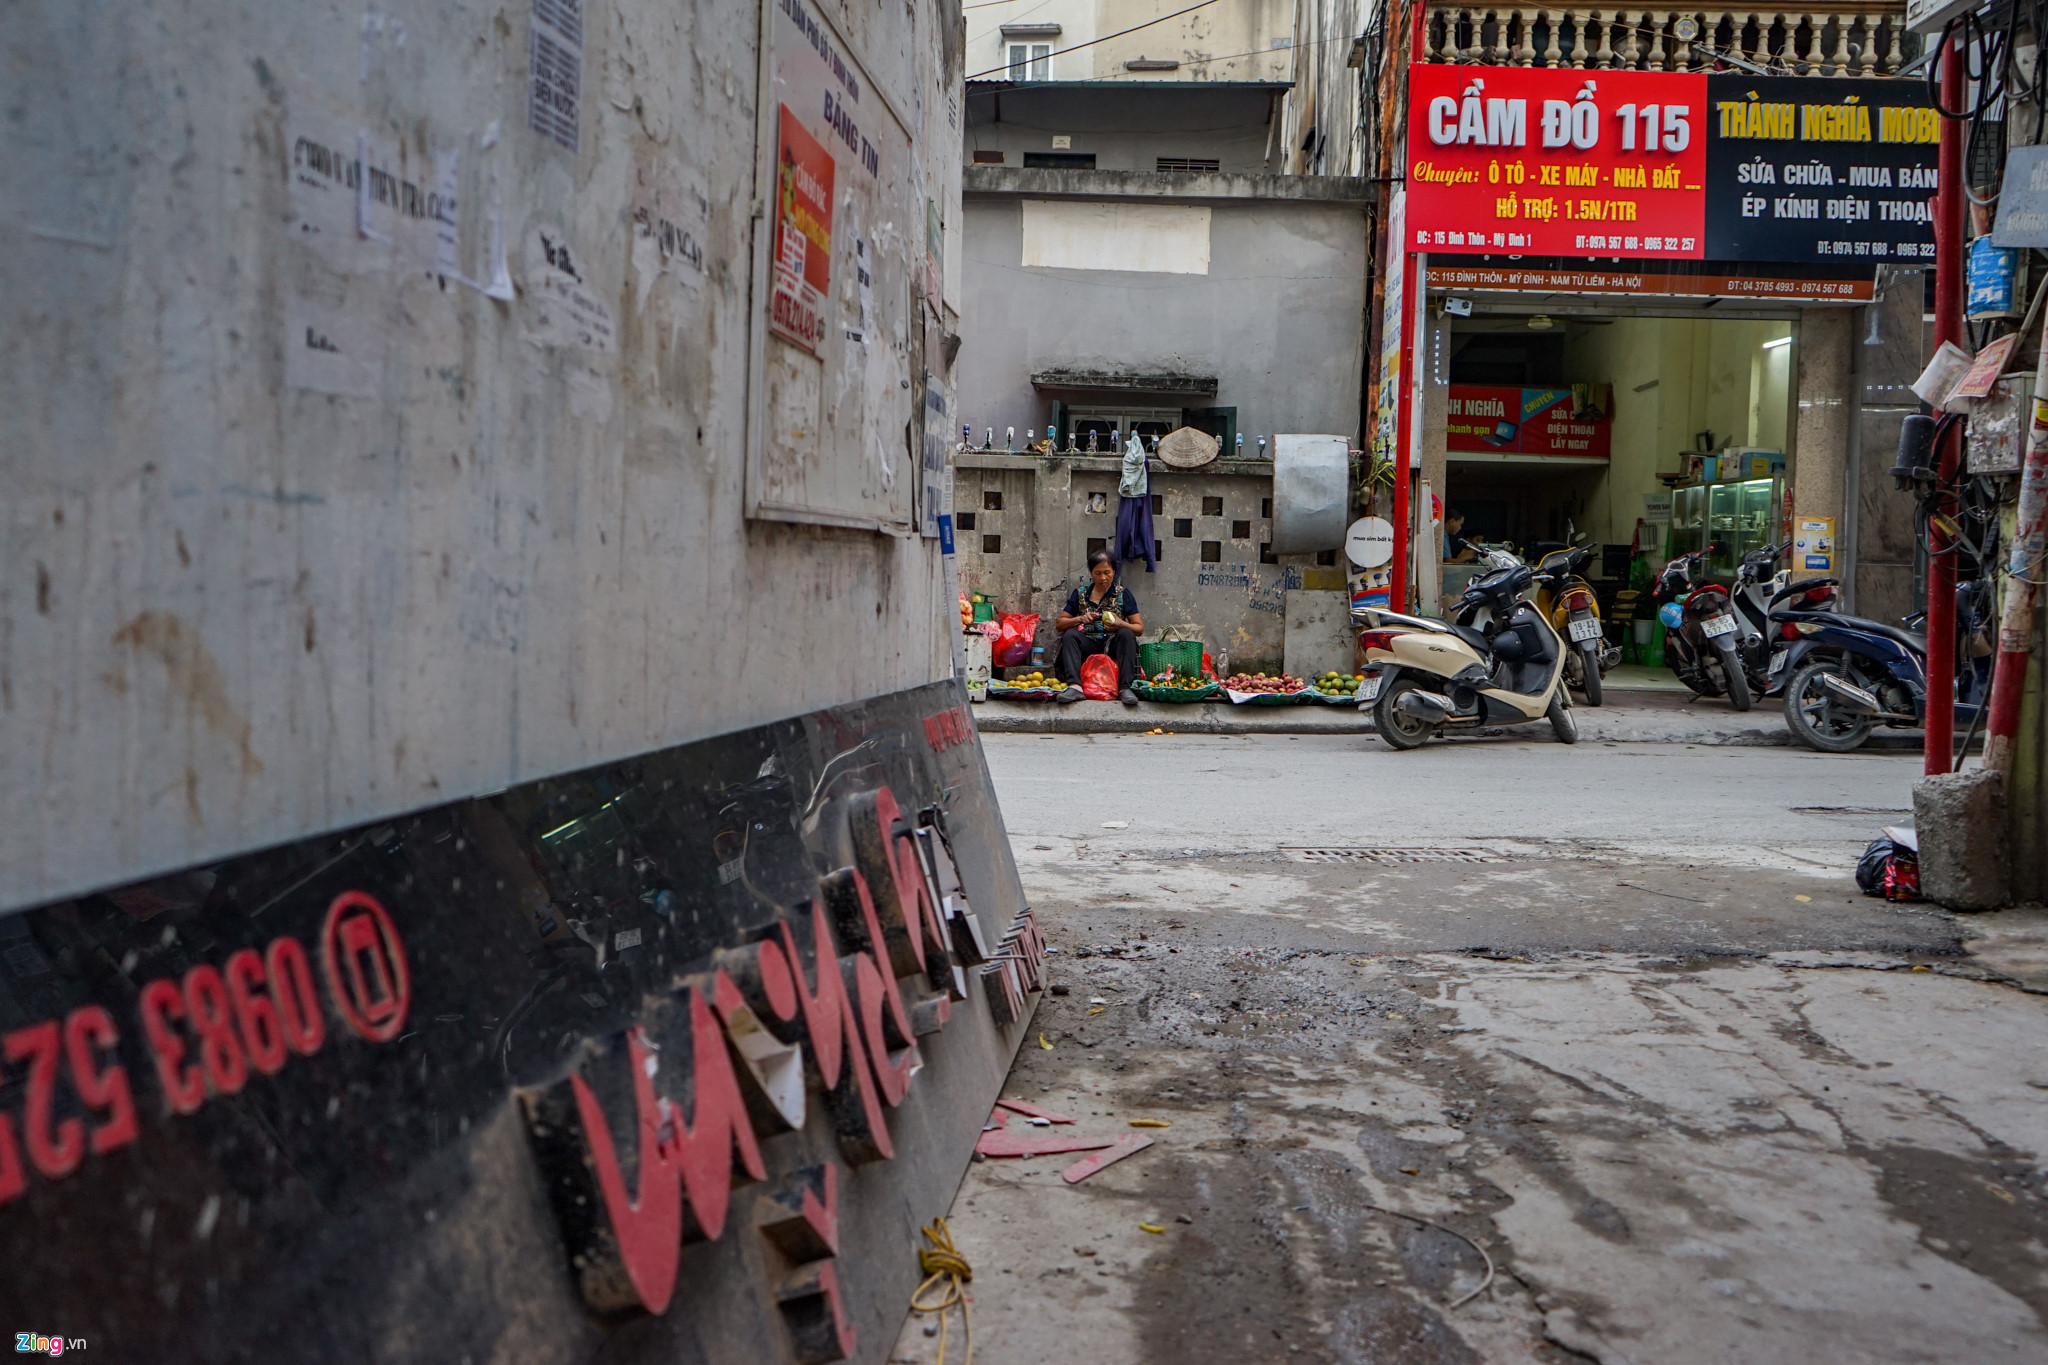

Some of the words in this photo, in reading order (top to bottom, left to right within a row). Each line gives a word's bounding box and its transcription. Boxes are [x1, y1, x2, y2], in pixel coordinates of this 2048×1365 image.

[1428, 78, 1527, 147] CẦM
[1541, 79, 1599, 150] ĐỒ
[1616, 103, 1690, 153] 115
[1716, 90, 1796, 141] THÀNH
[1801, 95, 1873, 143] NGHĨA
[1879, 106, 1941, 145] MOBI
[823, 88, 859, 155] BẢNG
[861, 134, 879, 180] TIN
[1413, 160, 1480, 188] Chuyên:
[1488, 160, 1500, 185] Ô
[1505, 159, 1525, 185] TÔ
[1540, 164, 1561, 187] XE
[1565, 162, 1600, 187] MÁY
[1613, 164, 1647, 188] NHÀ
[1652, 163, 1682, 190] ĐẤT
[1737, 155, 1777, 186] SỬA
[1783, 158, 1835, 187] CHỮA
[1849, 165, 1893, 189] MUA
[1898, 163, 1938, 189] BÁN
[1496, 190, 1518, 219] HỖ
[1522, 196, 1558, 223] TRỢ:
[1564, 199, 1638, 222] 1.5N/1TR
[1741, 191, 1768, 218] ÉP
[1774, 192, 1819, 220] KÍNH
[1826, 194, 1870, 225] ĐIỆN
[1434, 230, 1446, 245] 115
[1467, 232, 1486, 247] Thôn
[1493, 232, 1505, 249] Mỹ
[1608, 236, 1622, 250] 567
[1624, 236, 1638, 251] 688
[1644, 236, 1662, 252] 0965
[1664, 237, 1678, 252] 322
[1681, 237, 1695, 252] 257
[1832, 241, 1853, 257] 0974
[1854, 241, 1870, 257] 567
[1872, 242, 1888, 256] 688
[1897, 242, 1918, 257] 0965
[1920, 243, 1936, 257] 322
[1442, 271, 1455, 282] 115
[1456, 269, 1477, 284] ĐÌNH
[1479, 271, 1503, 285] THÔN
[1509, 271, 1522, 285] MỸ
[1523, 272, 1544, 286] ĐÌNH
[1550, 275, 1570, 286] NAM
[1571, 273, 1584, 287] TỪ
[1585, 274, 1606, 287] LIÊM
[1612, 274, 1624, 287] HÀ
[1625, 275, 1642, 290] NỘI
[1754, 281, 1774, 293] 3785
[1775, 281, 1795, 293] 4993
[1801, 283, 1821, 294] 0974
[1822, 284, 1838, 294] 567
[1838, 284, 1853, 295] 688
[1465, 397, 1505, 417] NGHĨA
[1551, 407, 1568, 420] SỬA
[1473, 426, 1490, 437] gọn
[1547, 422, 1568, 436] ĐIỆN
[1570, 425, 1595, 437] THOẠI
[1551, 436, 1567, 449] LẤY
[1568, 439, 1589, 450] NGAY
[139, 936, 326, 1116] 0983
